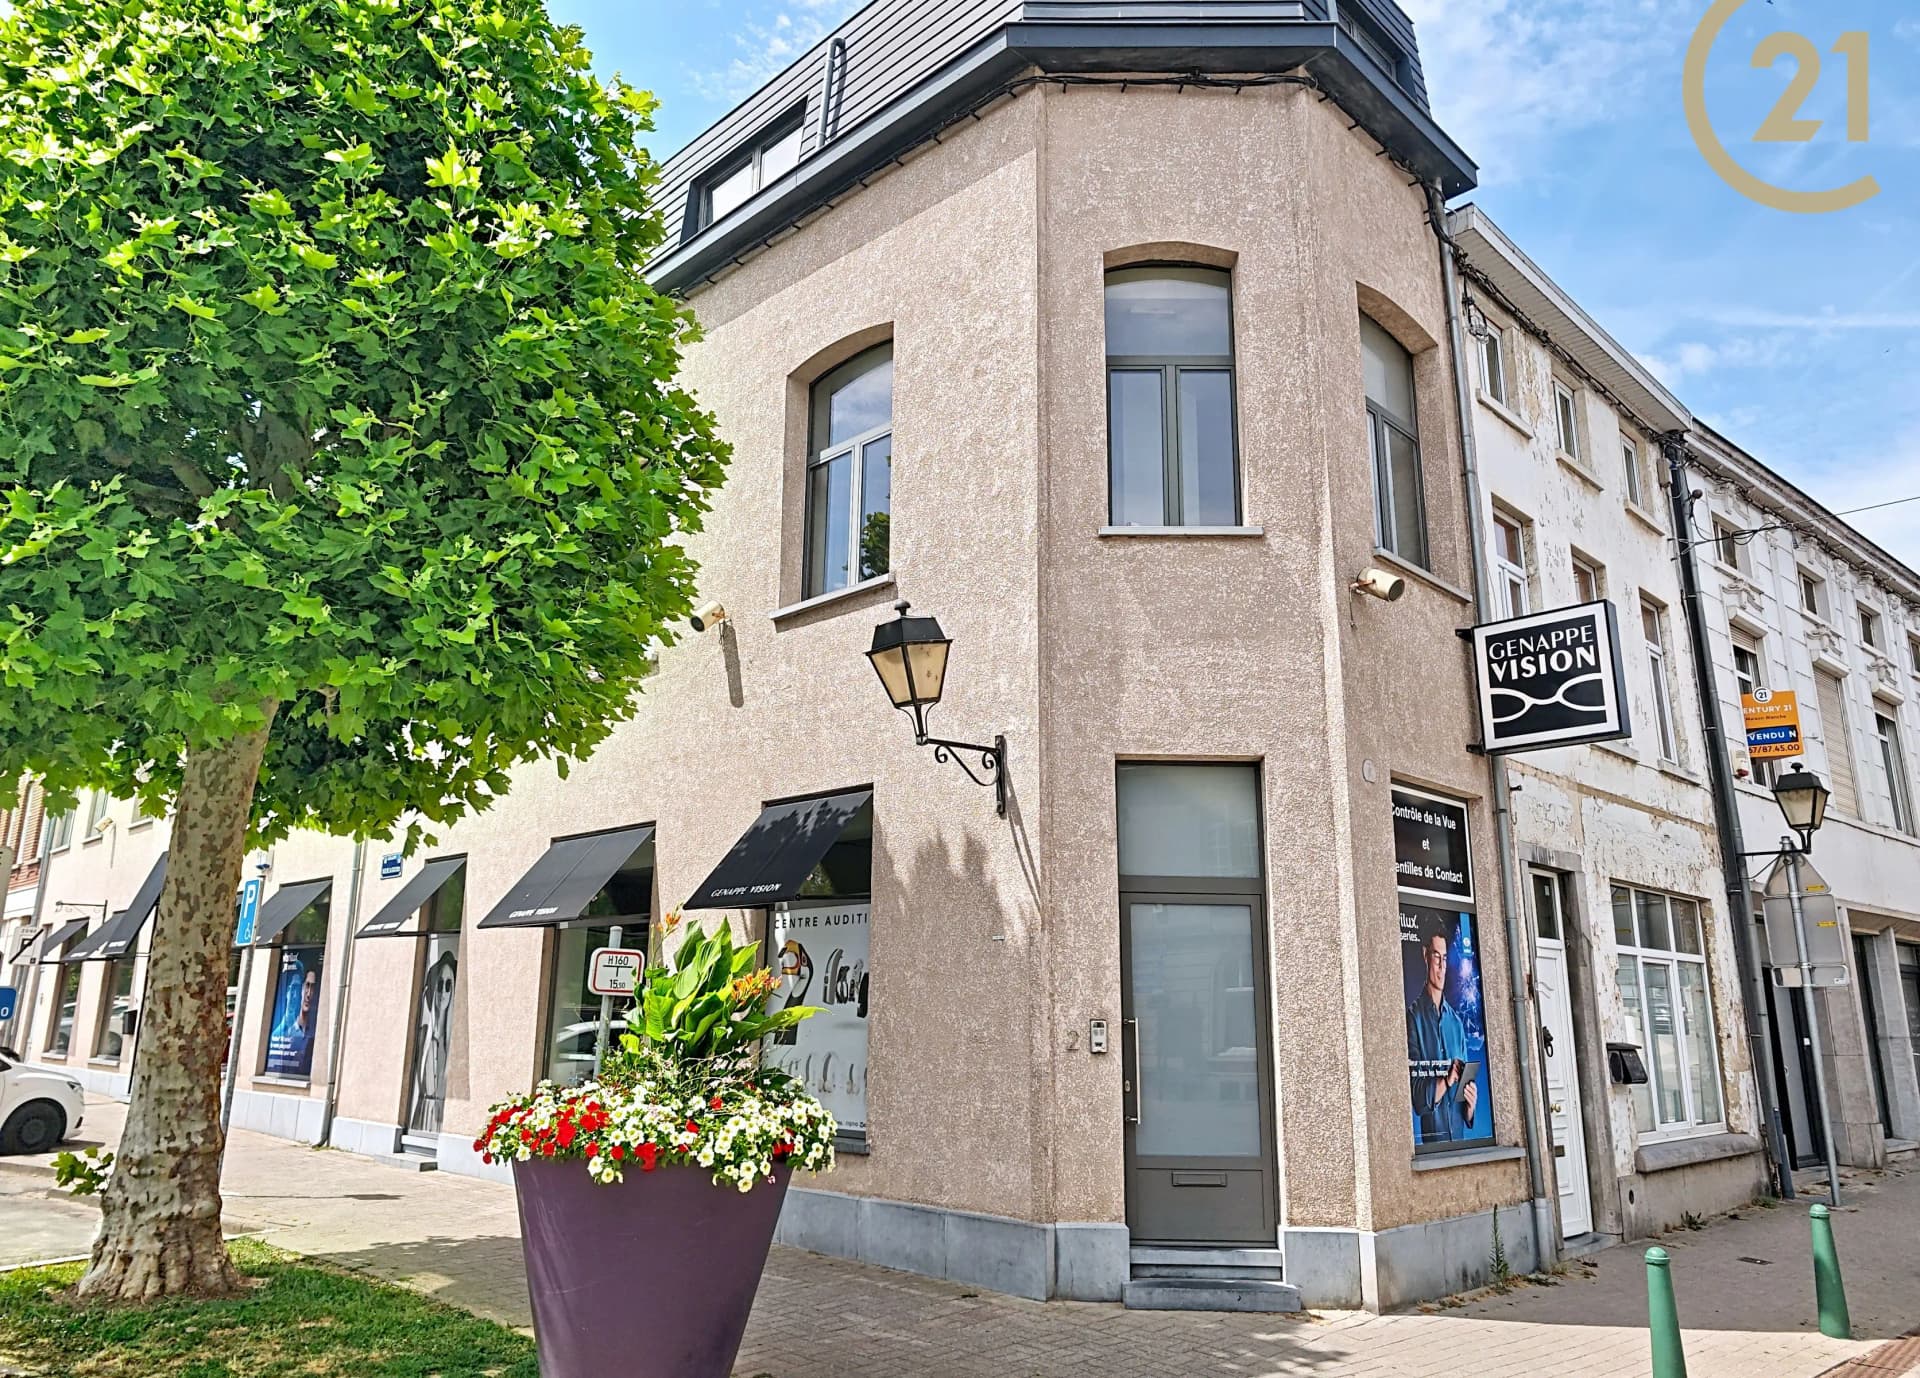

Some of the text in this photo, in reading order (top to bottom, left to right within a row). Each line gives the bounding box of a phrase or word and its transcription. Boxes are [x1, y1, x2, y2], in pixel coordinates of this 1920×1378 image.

[1488, 624, 1593, 660] GENAPPE
[1490, 644, 1597, 683] VISION
[1744, 705, 1780, 714] ENTURY
[1750, 732, 1785, 740] VENDU
[1424, 811, 1433, 824] de
[1434, 812, 1441, 826] la
[1442, 814, 1456, 829] Vue
[1422, 838, 1430, 851] et
[1395, 861, 1464, 884] entilles de Contact
[711, 883, 782, 897] GENAPPE VISION
[243, 884, 257, 919] P
[774, 913, 868, 929] CENTRE AUDITI
